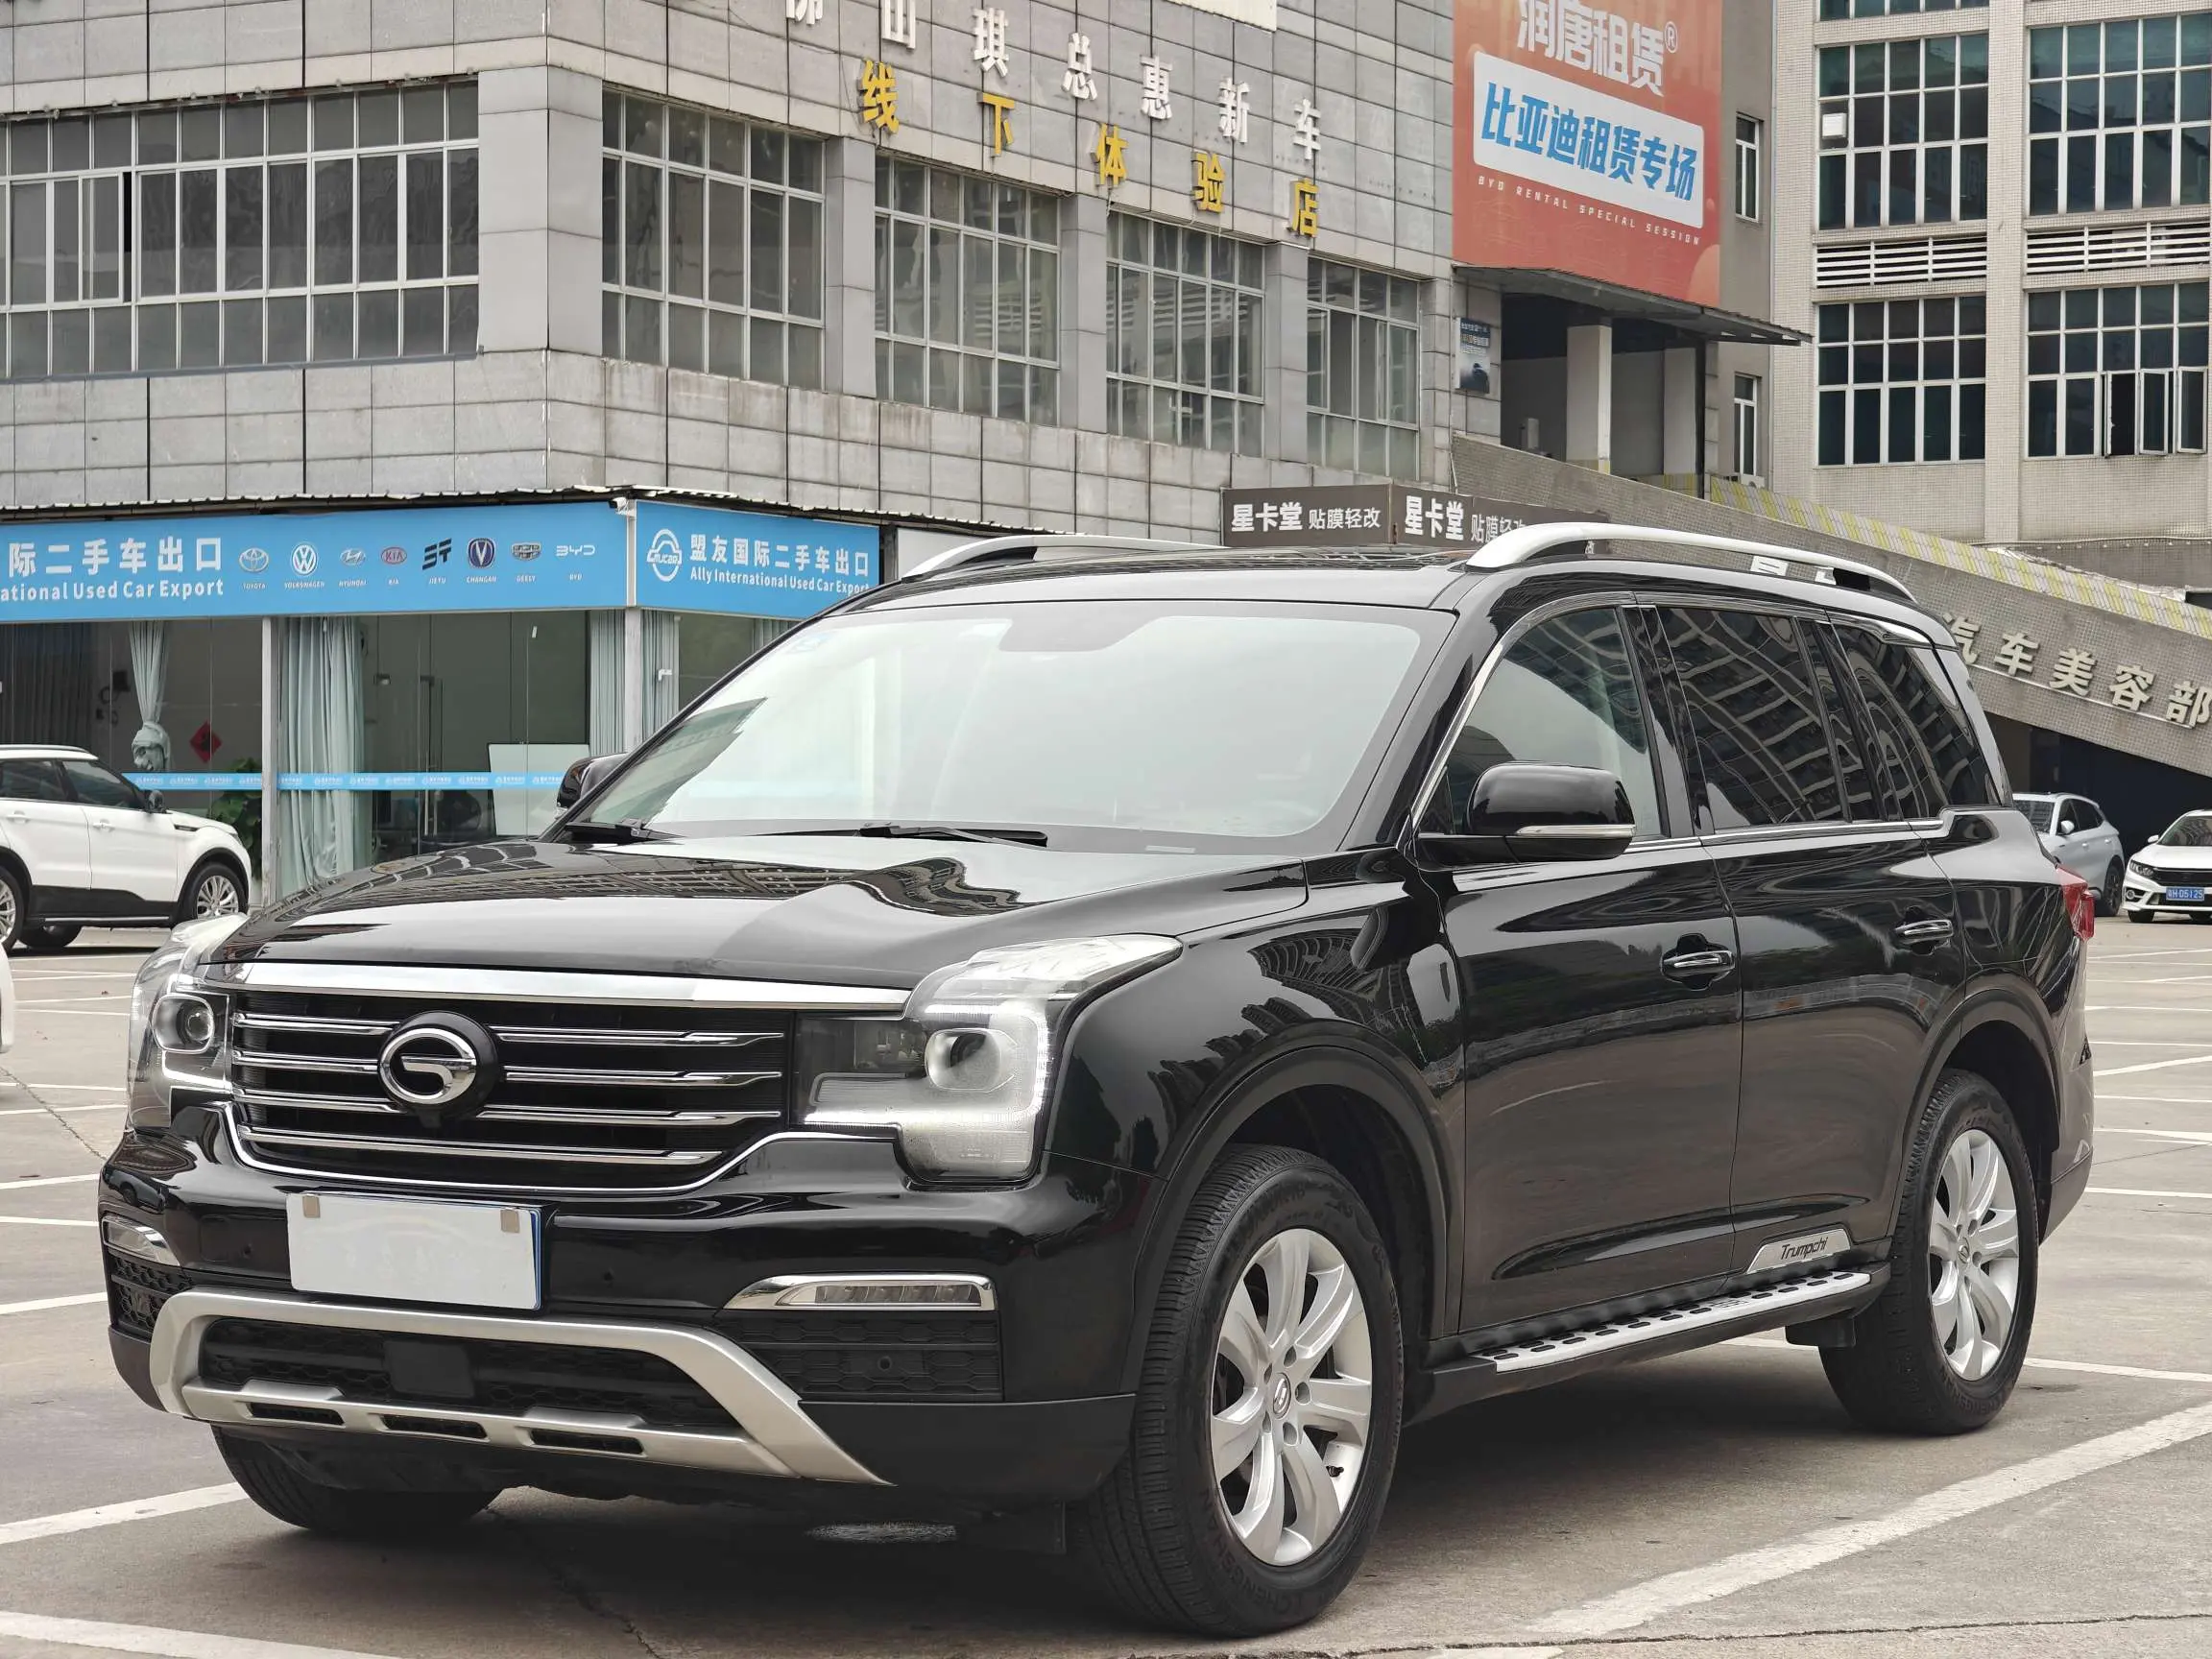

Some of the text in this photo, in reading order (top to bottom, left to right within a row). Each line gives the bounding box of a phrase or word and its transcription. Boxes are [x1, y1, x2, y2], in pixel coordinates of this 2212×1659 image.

[1481, 82, 1697, 201] 比亚迪租赁专场
[1516, 185, 1568, 210] RENTAL
[1579, 204, 1635, 228] SPECIAL
[1646, 223, 1700, 246] SESSION
[1232, 502, 1382, 532] 星卡堂 贴膜轻改
[1405, 495, 1464, 541] 星卡堂
[9, 536, 222, 578] 际二手车出口
[689, 533, 869, 578] 盟友国际二手车出口
[73, 582, 117, 600] Used
[123, 581, 154, 598] Car
[159, 578, 224, 600] Export
[690, 566, 711, 585] Ally
[714, 570, 787, 589] International
[790, 577, 814, 590] Used
[817, 578, 833, 592] Car
[1781, 1237, 1828, 1260] Trumpchi
